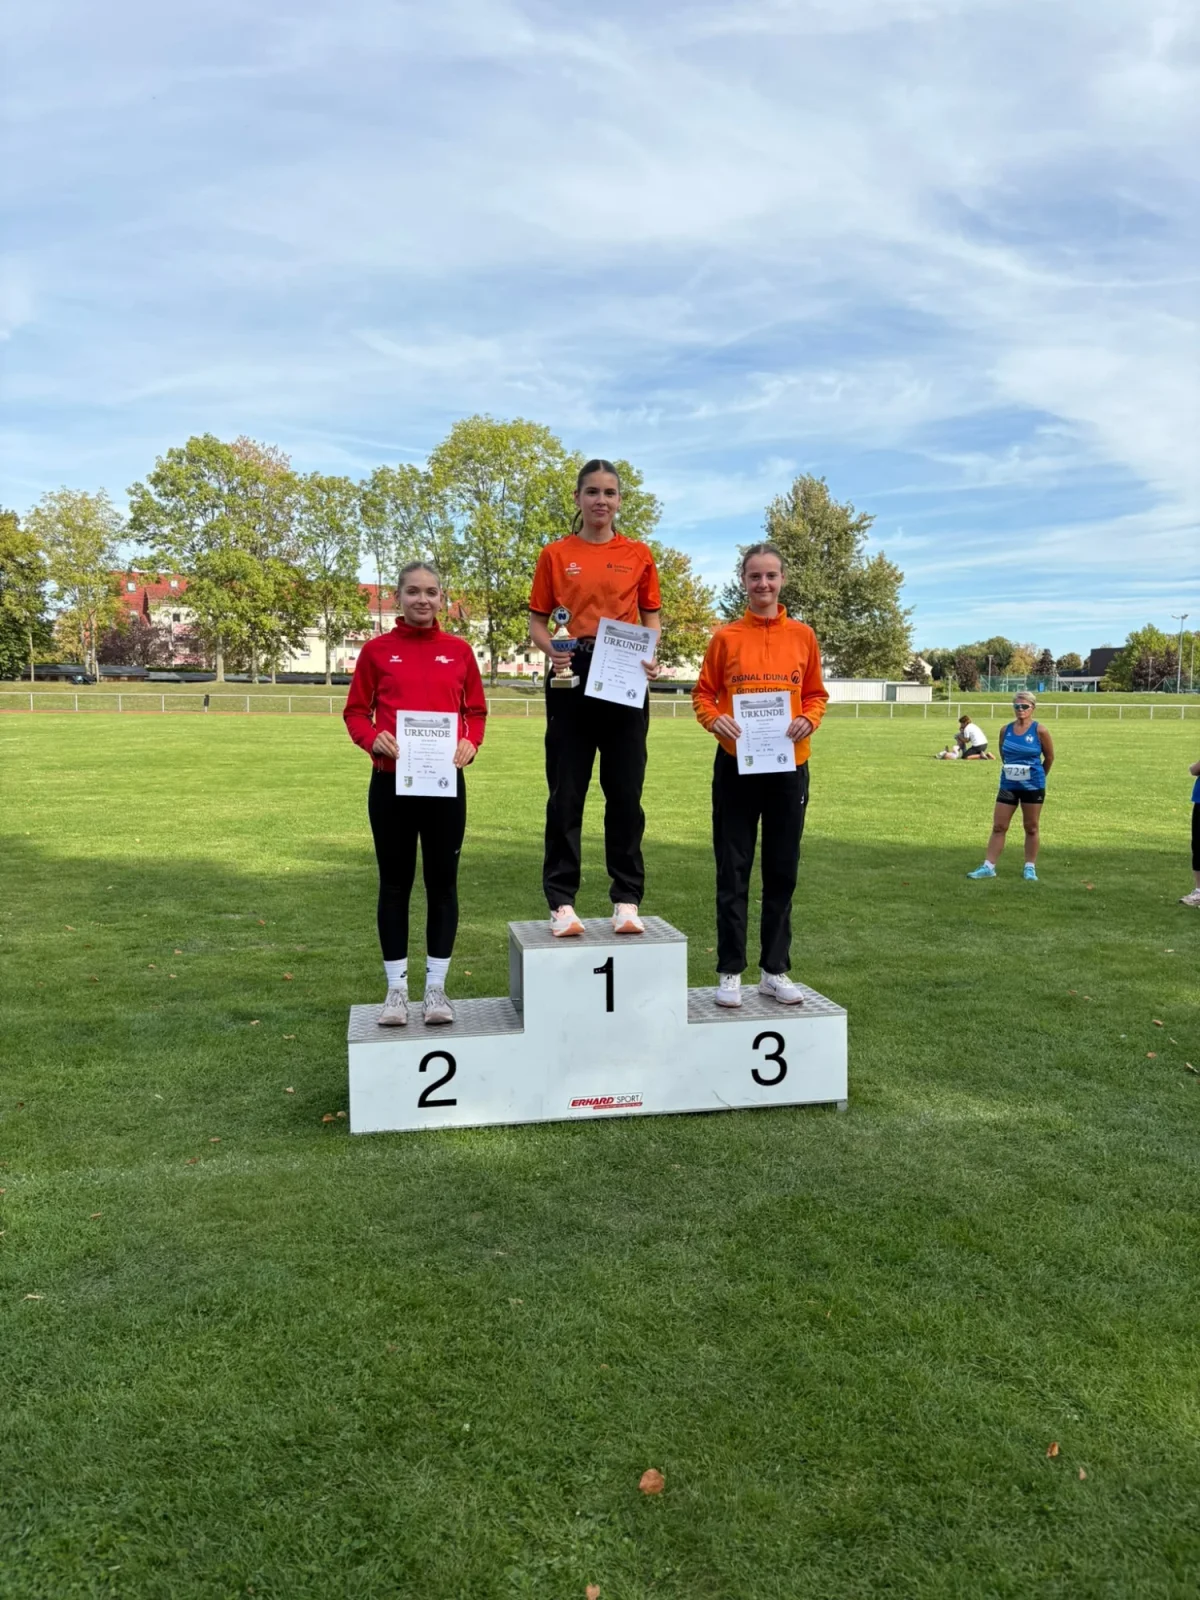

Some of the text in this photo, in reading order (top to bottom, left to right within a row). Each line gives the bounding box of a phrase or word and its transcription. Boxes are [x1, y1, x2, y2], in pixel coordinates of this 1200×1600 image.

[603, 636, 649, 653] URKUNDE
[731, 673, 788, 683] SIGNAL IDUNA
[741, 708, 785, 718] URKUNDE
[404, 728, 451, 738] URKUNDE
[1007, 767, 1026, 777] 724
[593, 956, 614, 1012] 1
[751, 1031, 788, 1086] 3
[418, 1050, 457, 1108] 2
[571, 1096, 615, 1107] ERHARD
[616, 1094, 640, 1104] SPORT
